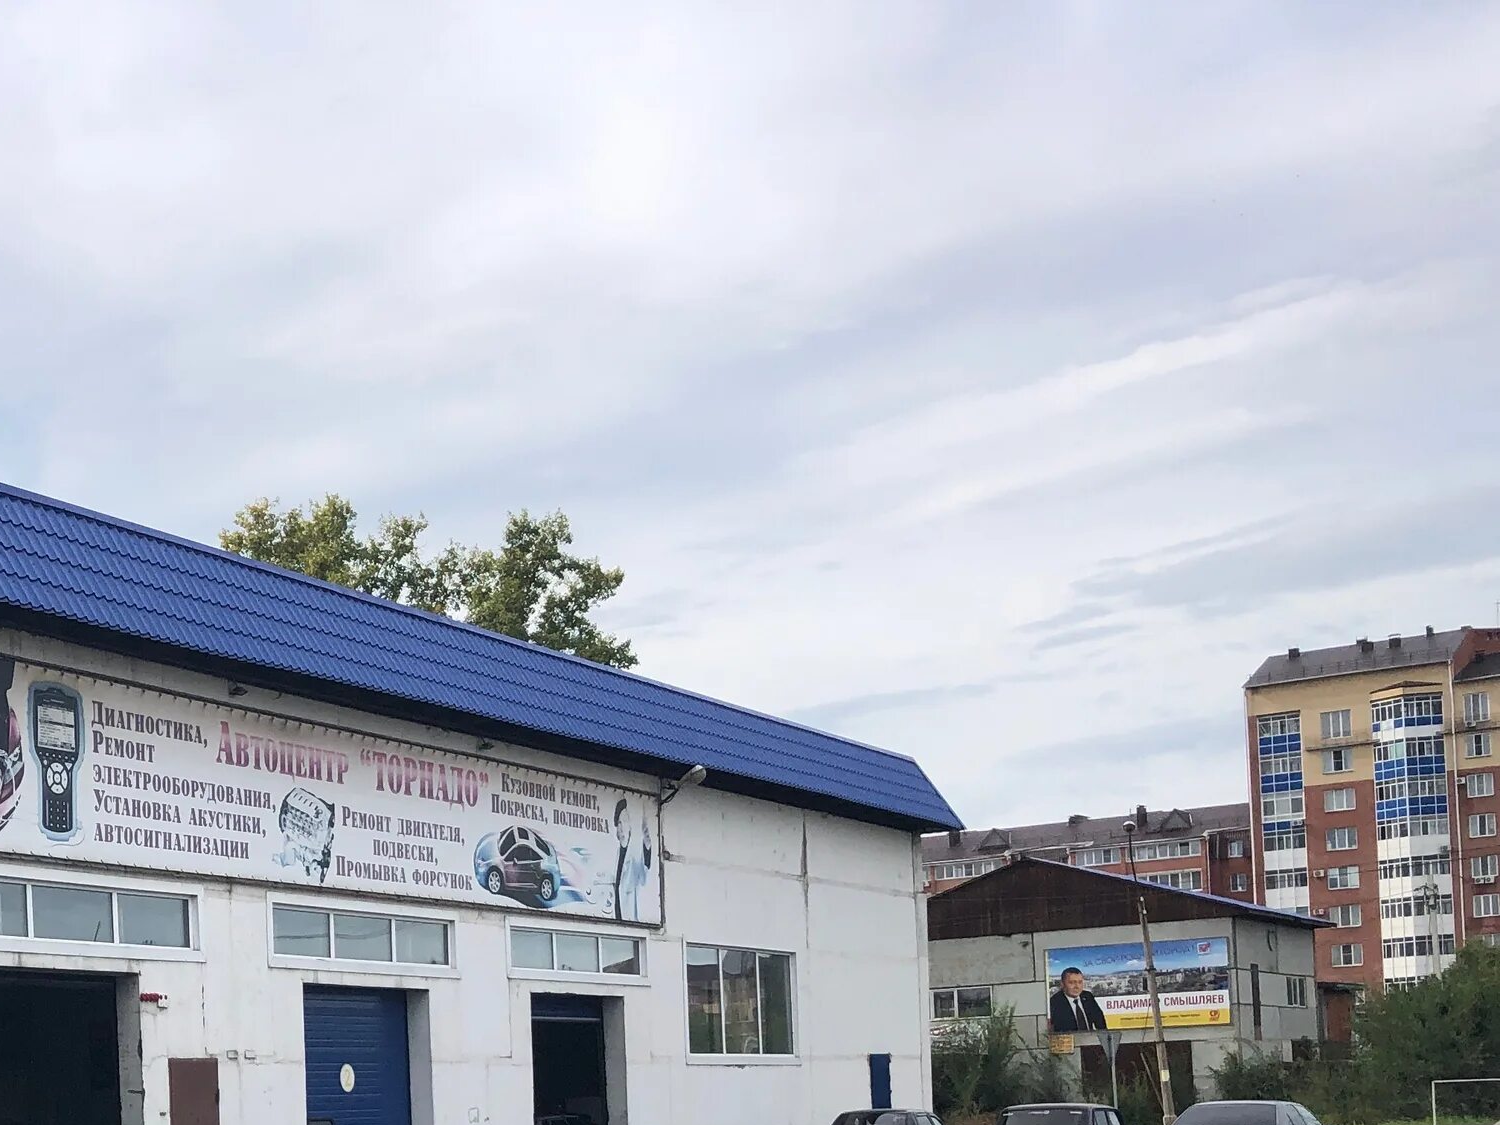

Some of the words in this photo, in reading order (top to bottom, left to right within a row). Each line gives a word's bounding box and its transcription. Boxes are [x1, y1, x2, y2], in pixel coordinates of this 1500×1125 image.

[93, 822, 250, 860] АВТОСИГНАЛИЗАЦИИ
[1106, 998, 1153, 1010] ВЛАДИМИ
[1163, 994, 1225, 1006] СМЫШЛЯЕВ
